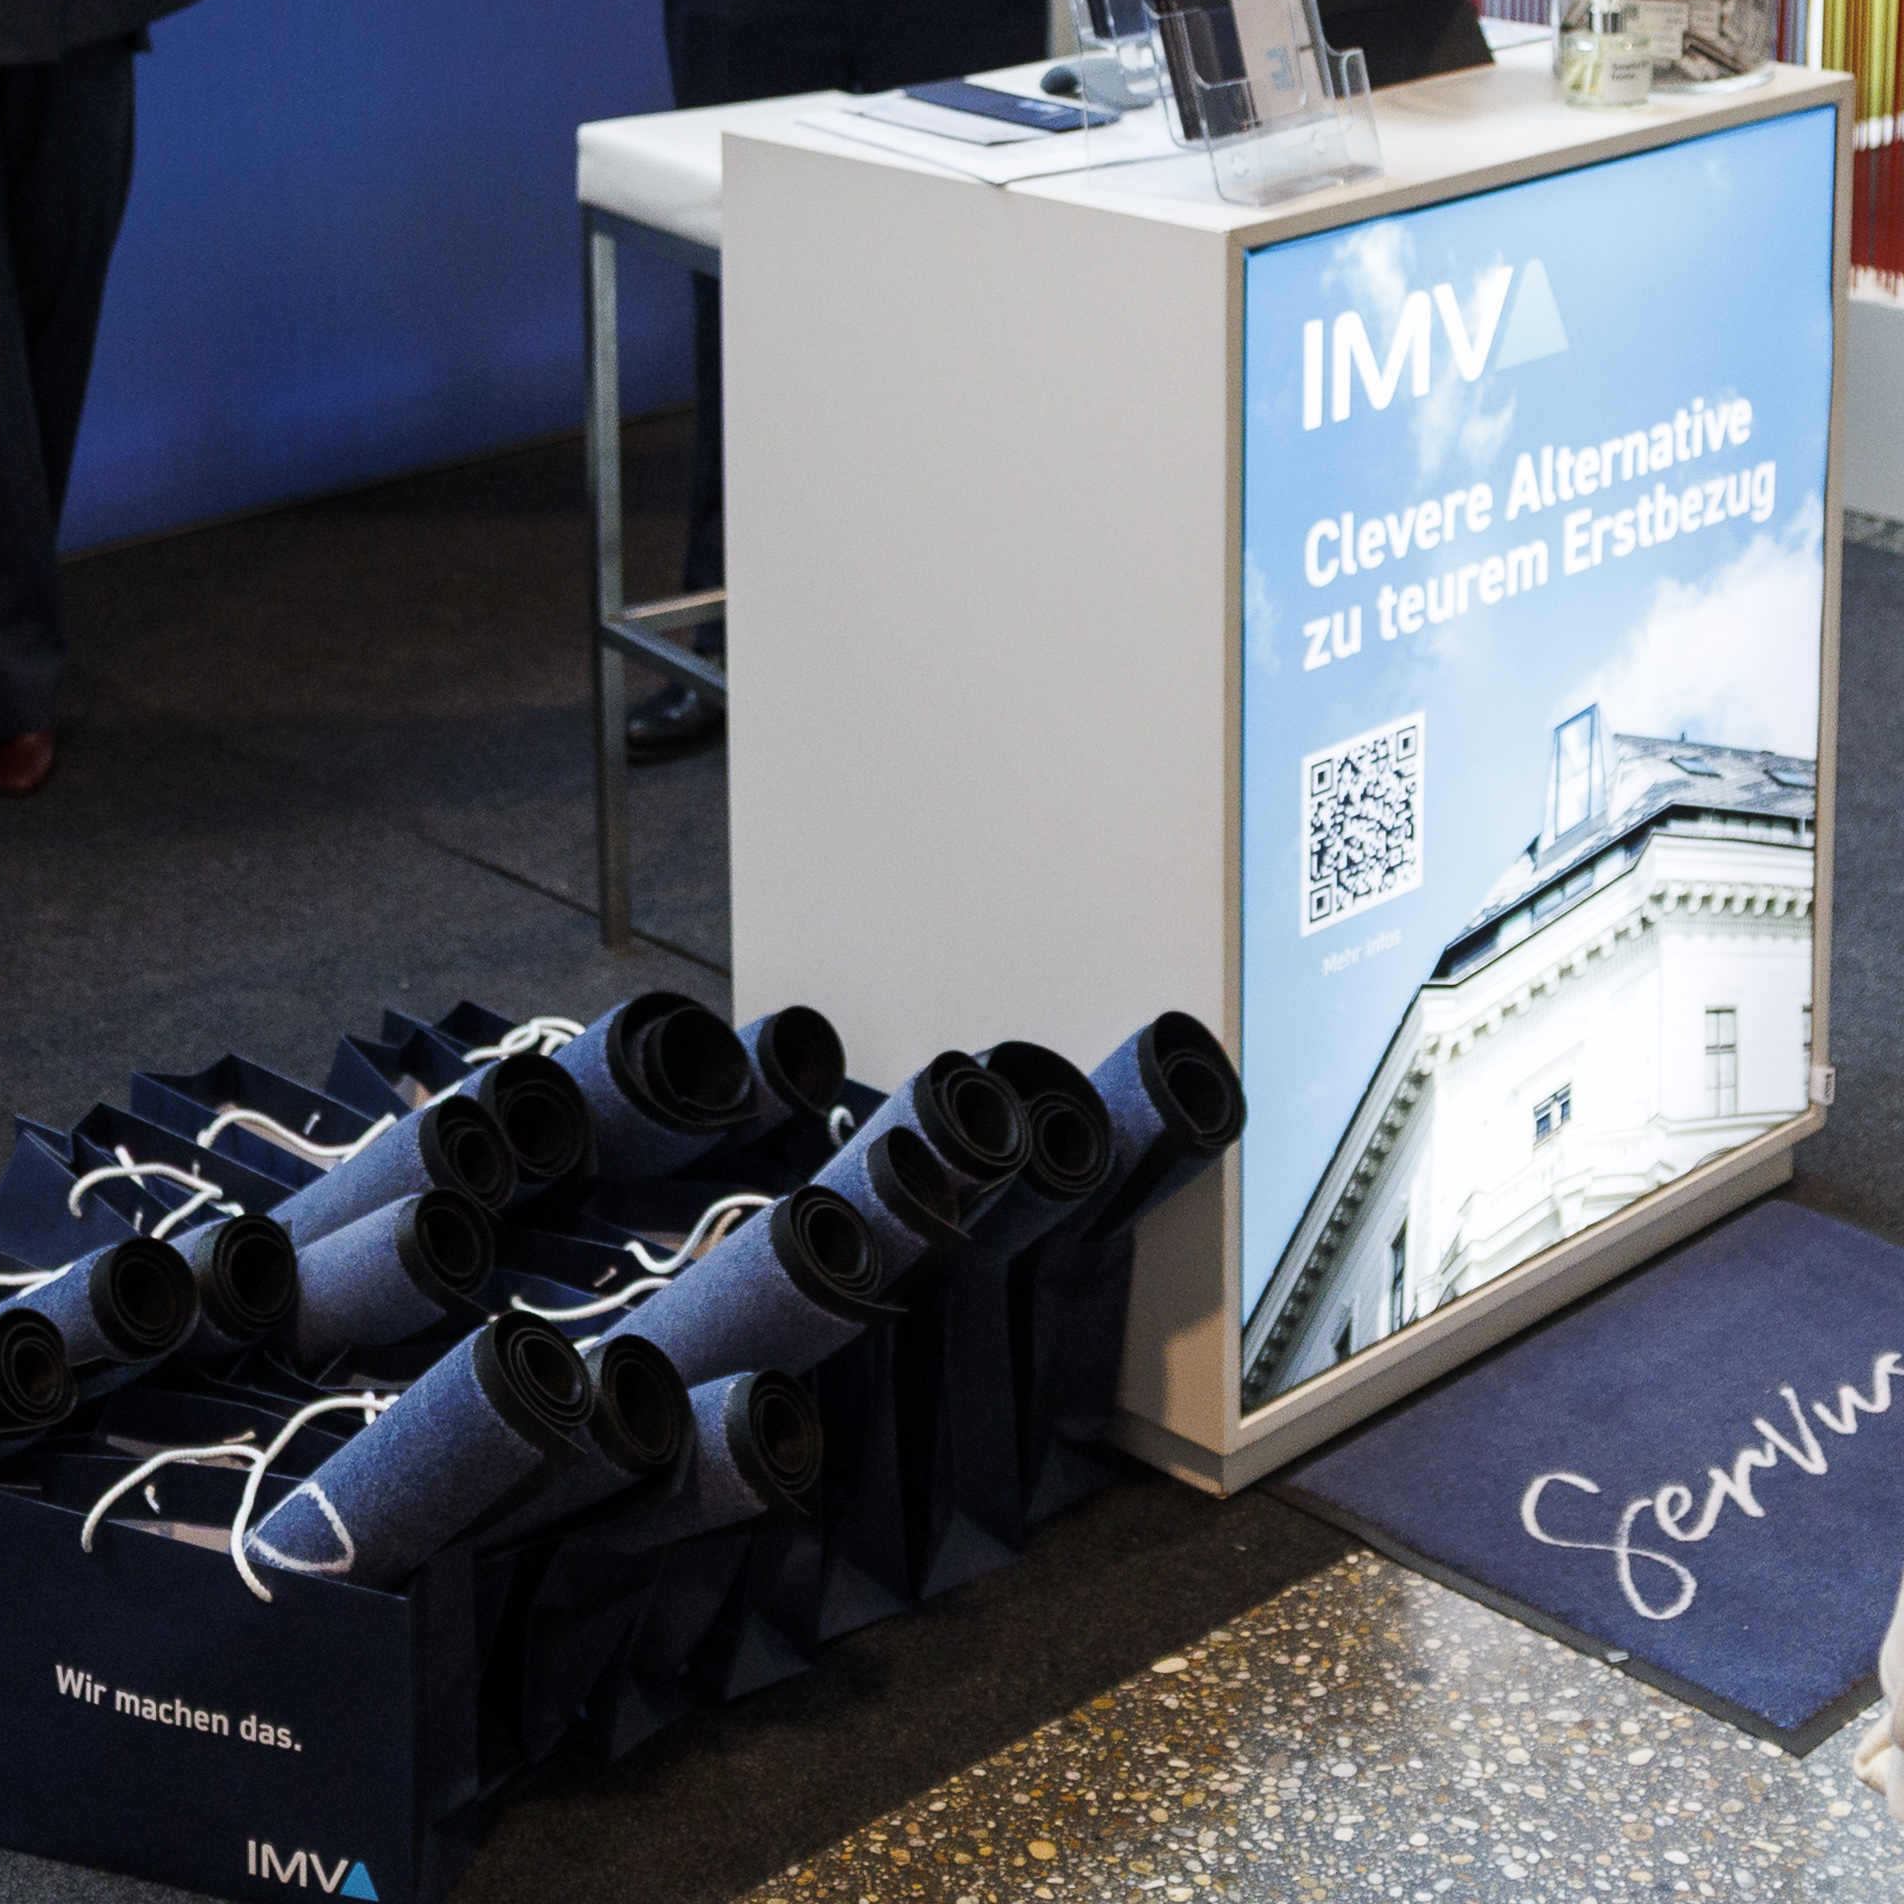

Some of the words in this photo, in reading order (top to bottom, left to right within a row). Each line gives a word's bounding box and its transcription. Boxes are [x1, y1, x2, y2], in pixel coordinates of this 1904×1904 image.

[1302, 481, 1494, 589] Clevere
[1506, 396, 1754, 522] Alternative
[1301, 606, 1363, 674] zu
[1377, 539, 1551, 643] teurem
[1562, 459, 1778, 578] Erstbezug
[1322, 946, 1363, 977] Mehr
[55, 1664, 107, 1705] Wir
[115, 1689, 230, 1737] machen
[240, 1714, 302, 1752] das.
